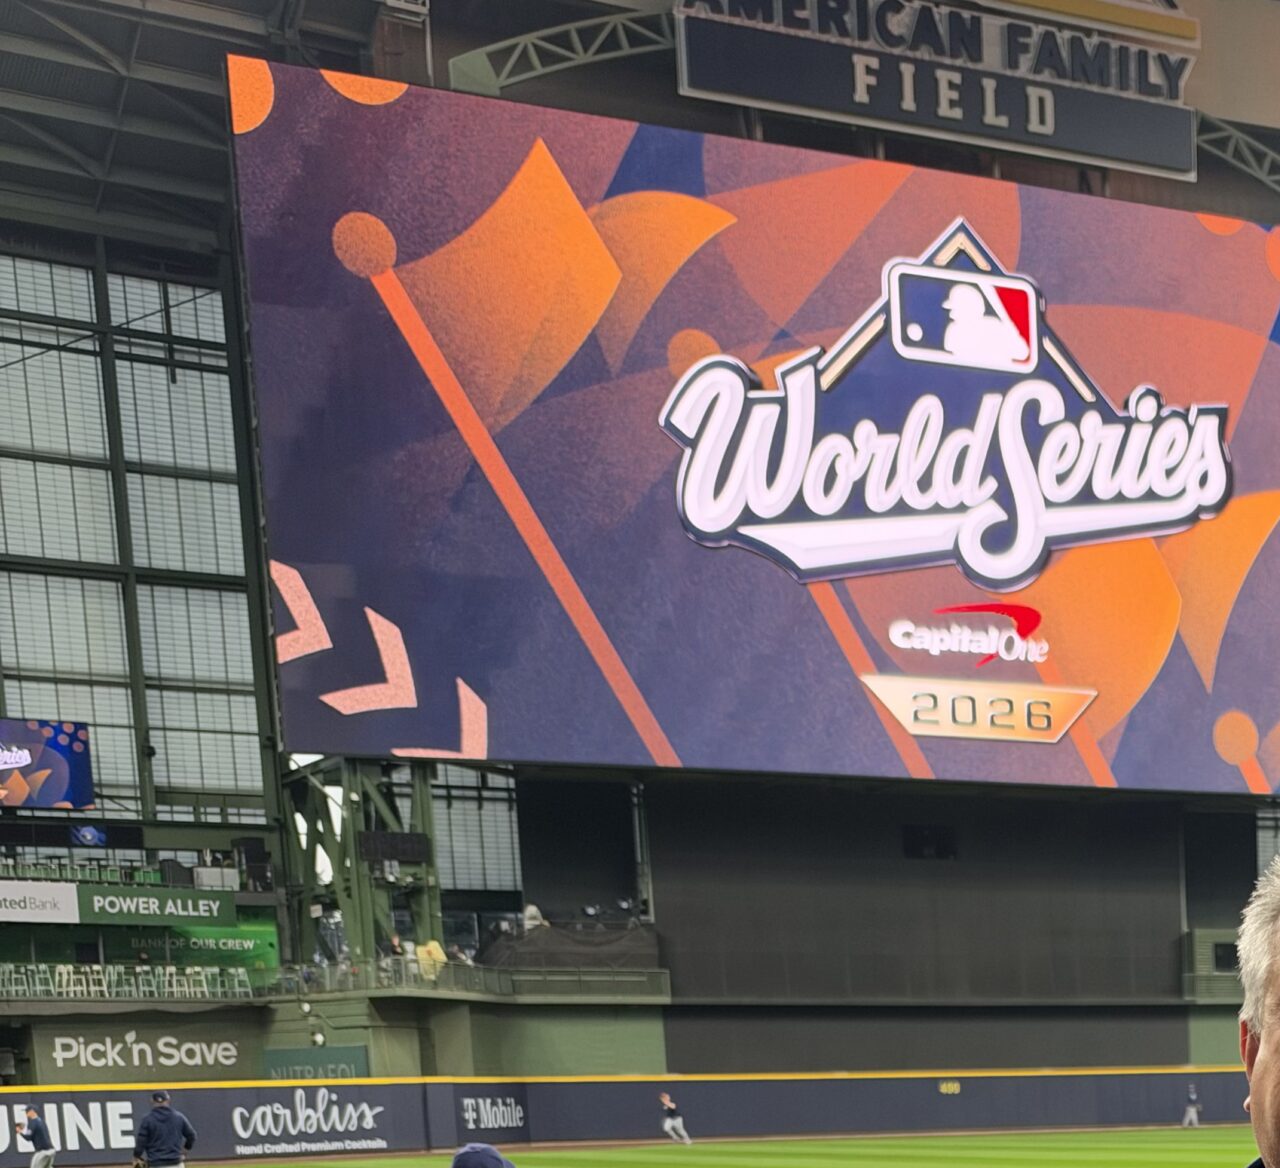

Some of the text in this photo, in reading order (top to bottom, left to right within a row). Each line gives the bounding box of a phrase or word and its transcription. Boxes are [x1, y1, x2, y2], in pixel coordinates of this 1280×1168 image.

[682, 0, 1190, 100] ERICAN FAMILY
[852, 53, 1056, 136] FIELD
[668, 363, 1228, 580] World Series
[911, 692, 1053, 731] 2026
[29, 896, 61, 911] Bank
[93, 895, 221, 917] POWER ALLEY
[189, 938, 217, 949] OUR
[219, 938, 255, 950] CREW
[157, 1036, 238, 1066] Save
[232, 1087, 385, 1140] carbliss
[479, 1097, 525, 1129] Mobile
[235, 1137, 388, 1155] Hand Crafted Premium Cocktails
